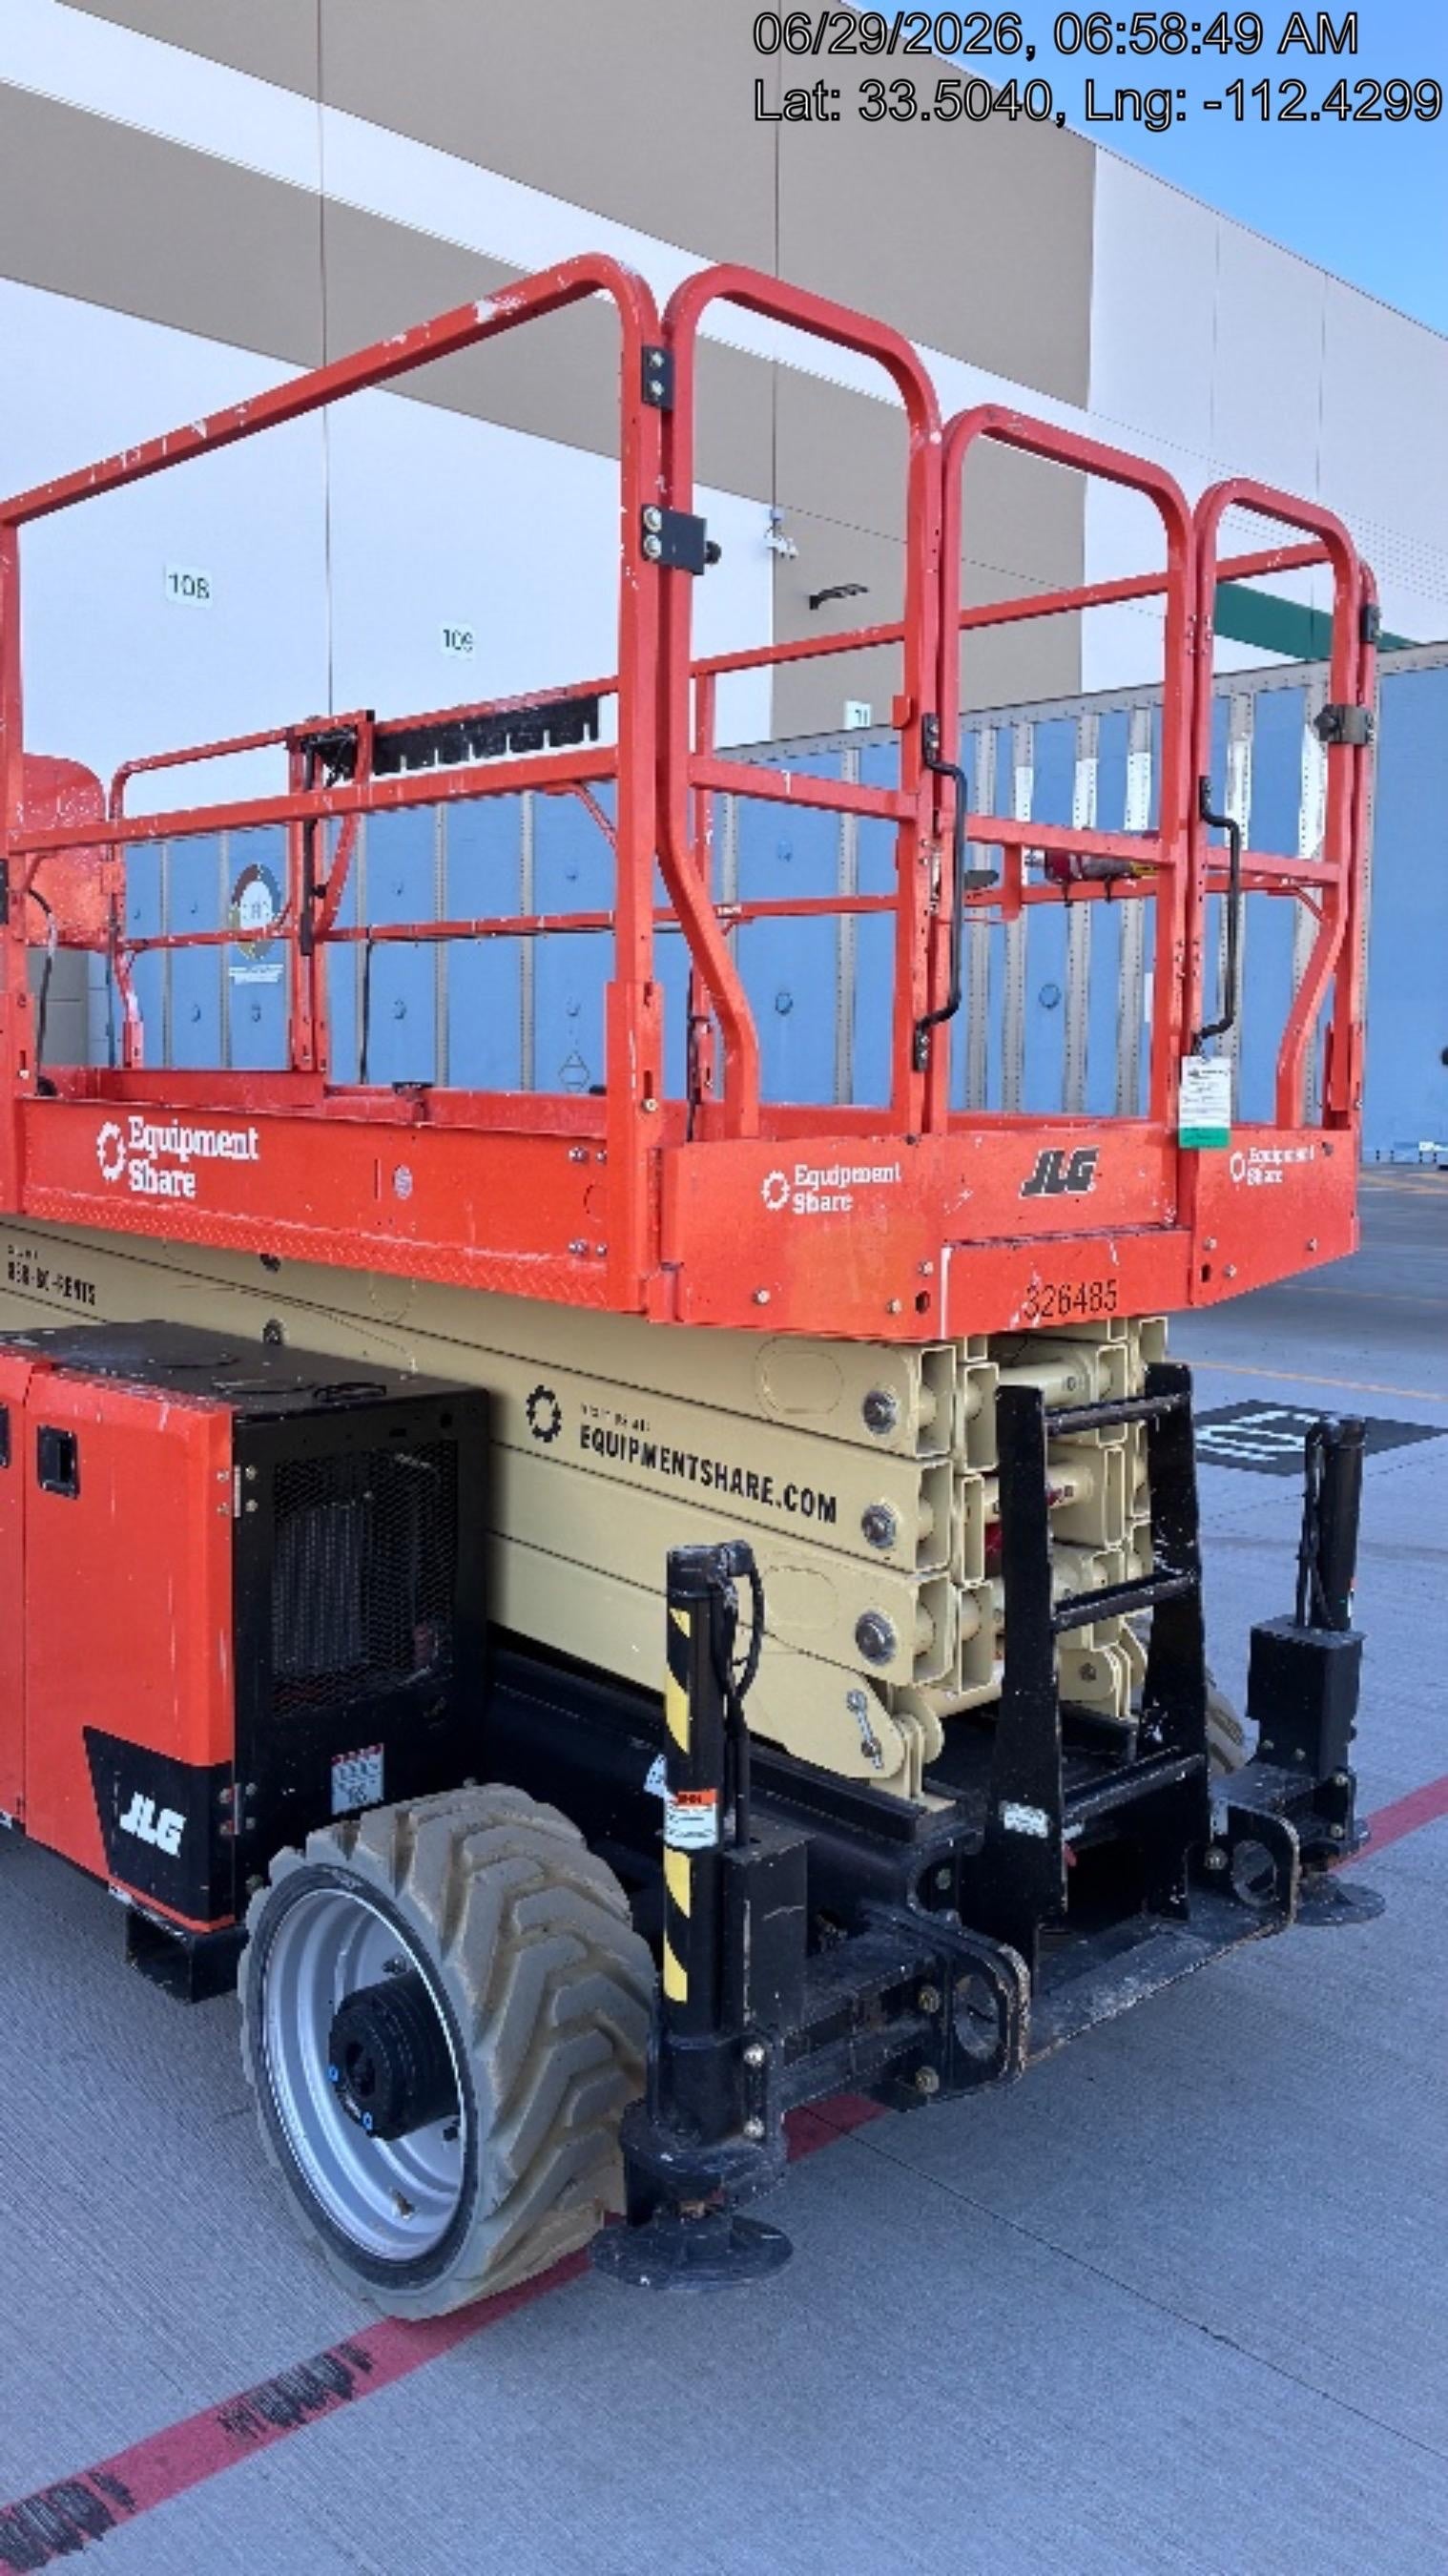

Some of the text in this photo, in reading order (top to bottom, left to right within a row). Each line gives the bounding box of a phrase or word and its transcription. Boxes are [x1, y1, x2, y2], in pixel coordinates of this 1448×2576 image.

[168, 572, 210, 600] 108
[128, 1115, 259, 1163] Equipment
[128, 1158, 197, 1198] Share
[794, 1161, 902, 1192] Equipment
[1019, 1145, 1100, 1199] JLG
[792, 1191, 854, 1215] Share
[1024, 1278, 1117, 1319] 326485
[579, 1425, 838, 1526] EQUIPMENTSHARE.COM
[119, 1791, 187, 1859] JLG
